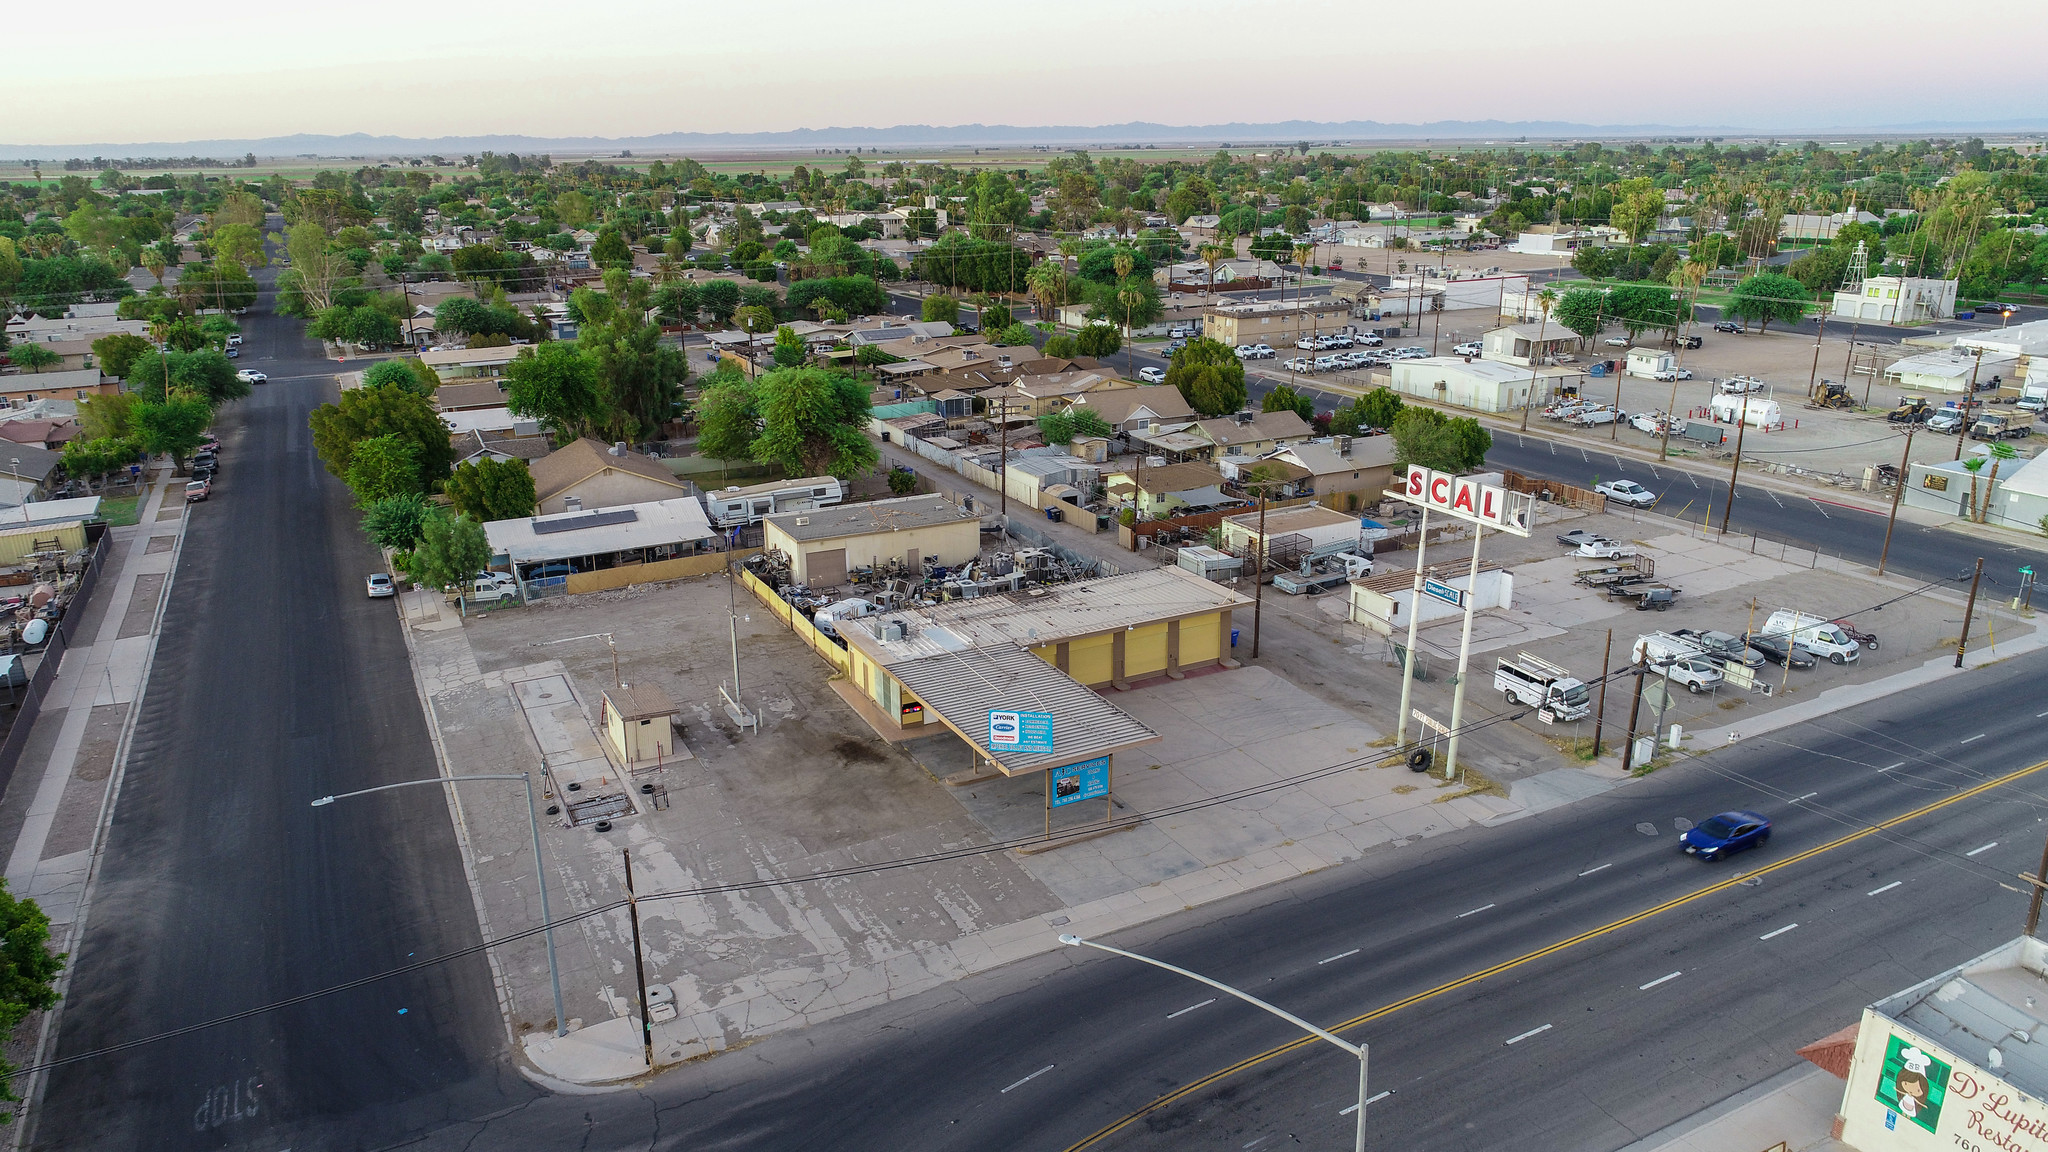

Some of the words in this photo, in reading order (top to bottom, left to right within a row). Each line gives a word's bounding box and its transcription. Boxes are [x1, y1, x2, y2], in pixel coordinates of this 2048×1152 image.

[1409, 471, 1496, 519] SCAL
[1072, 760, 1106, 772] SERVICES
[1967, 1109, 2029, 1152] Resta
